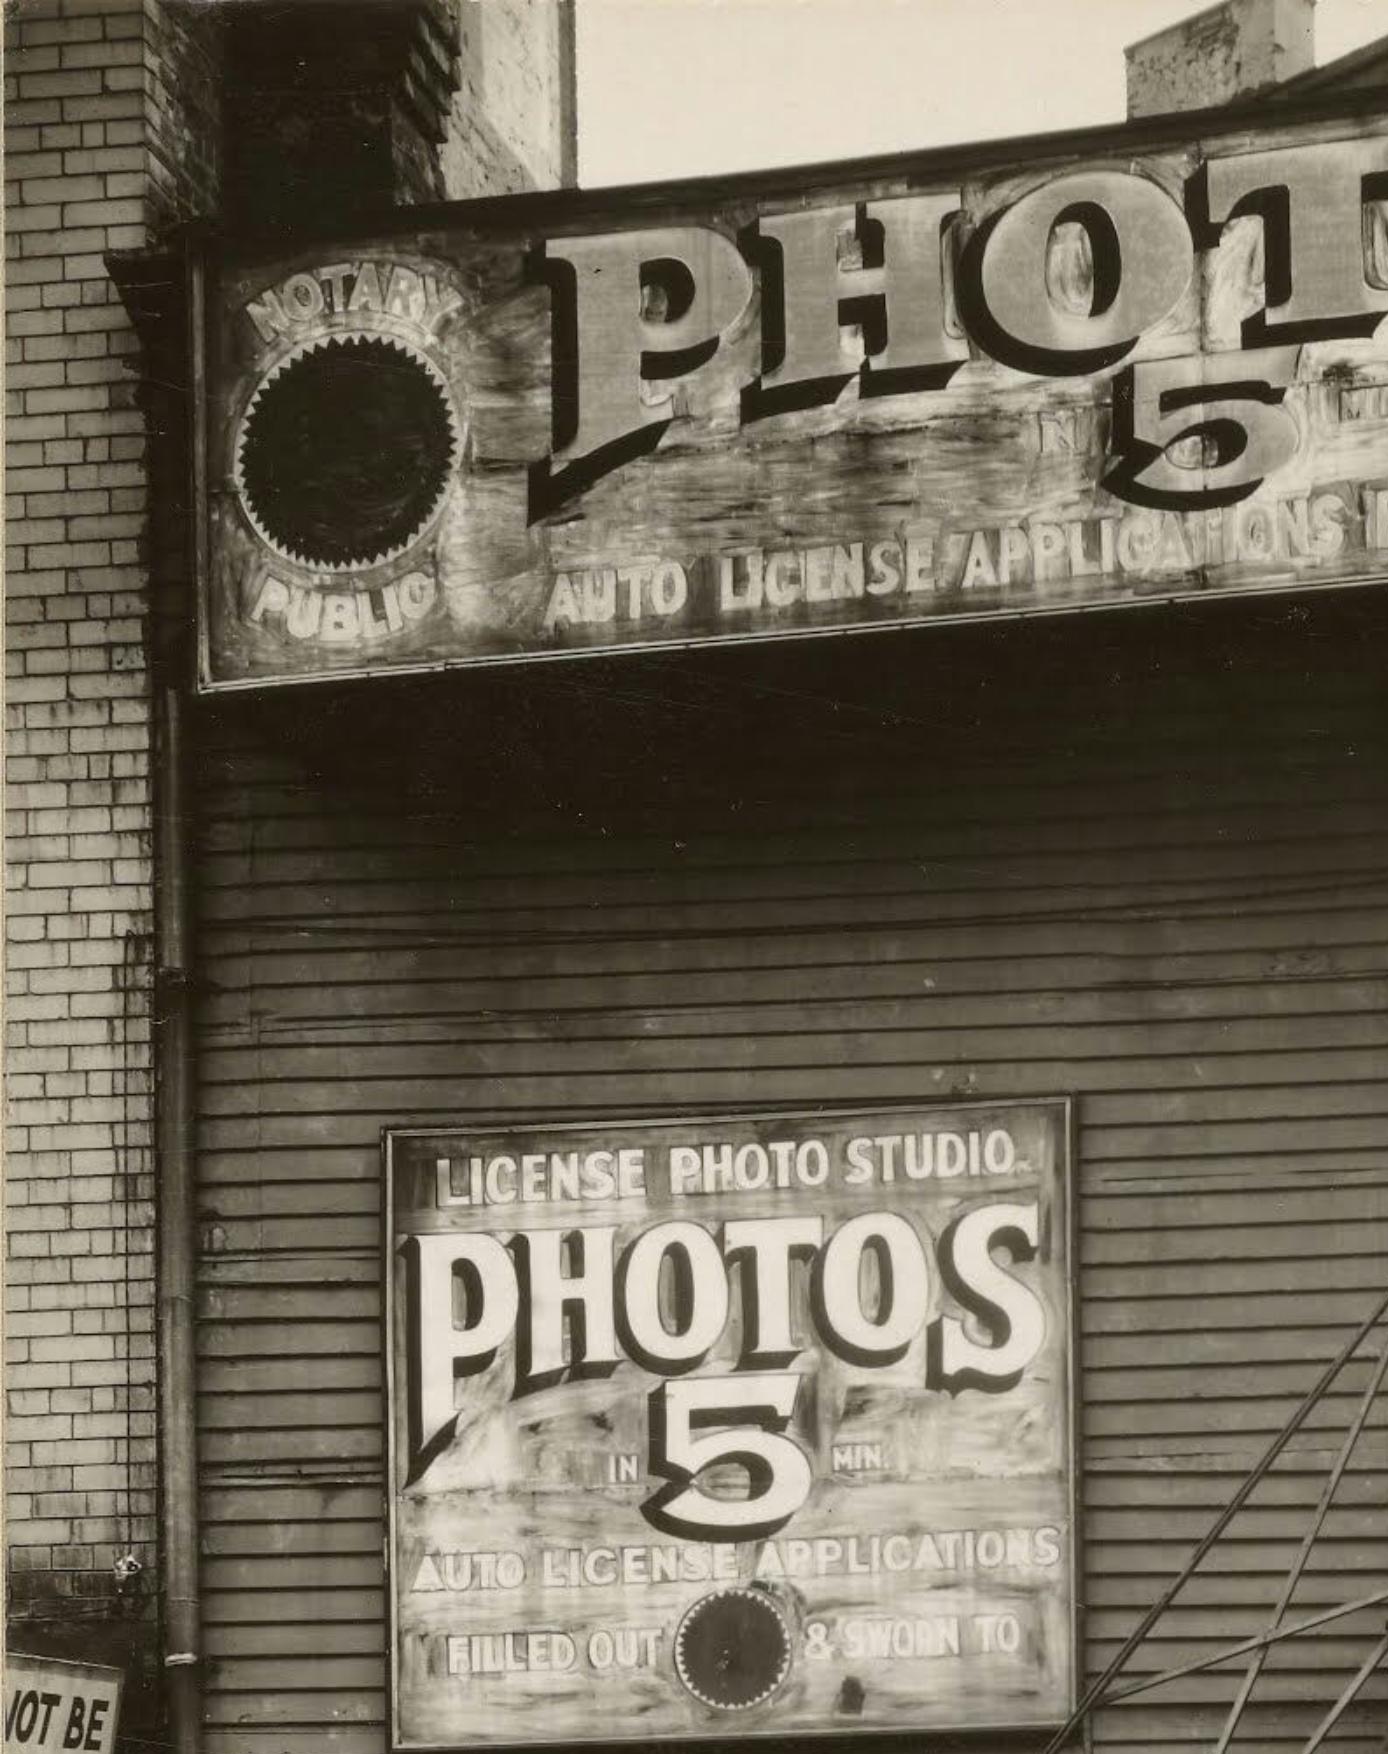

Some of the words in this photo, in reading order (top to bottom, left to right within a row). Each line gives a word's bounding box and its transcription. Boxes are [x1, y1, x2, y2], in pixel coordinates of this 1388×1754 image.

[246, 261, 463, 344] NOTARY
[1104, 345, 1299, 510] 5
[544, 561, 688, 625] AUTO
[720, 541, 935, 611] LICENSE
[961, 494, 1348, 590] APPLICATIONS
[250, 571, 440, 642] PUBLIC
[436, 1148, 647, 1207] LICENSE
[669, 1139, 830, 1195] PHOTO
[845, 1130, 1014, 1185] STUDIO
[402, 1202, 1046, 1490] PHOTOS
[609, 1455, 639, 1483] IN
[642, 1373, 814, 1545] 5
[832, 1443, 892, 1471] MIN.
[412, 1552, 526, 1594] AUTO
[543, 1541, 740, 1589] LICENSE
[756, 1526, 1062, 1578] APPLICATIONS
[448, 1633, 576, 1675] FILLED
[588, 1629, 665, 1670] OUT
[803, 1622, 833, 1660] &
[979, 1613, 1021, 1655] TO
[63, 1696, 109, 1751] BE
